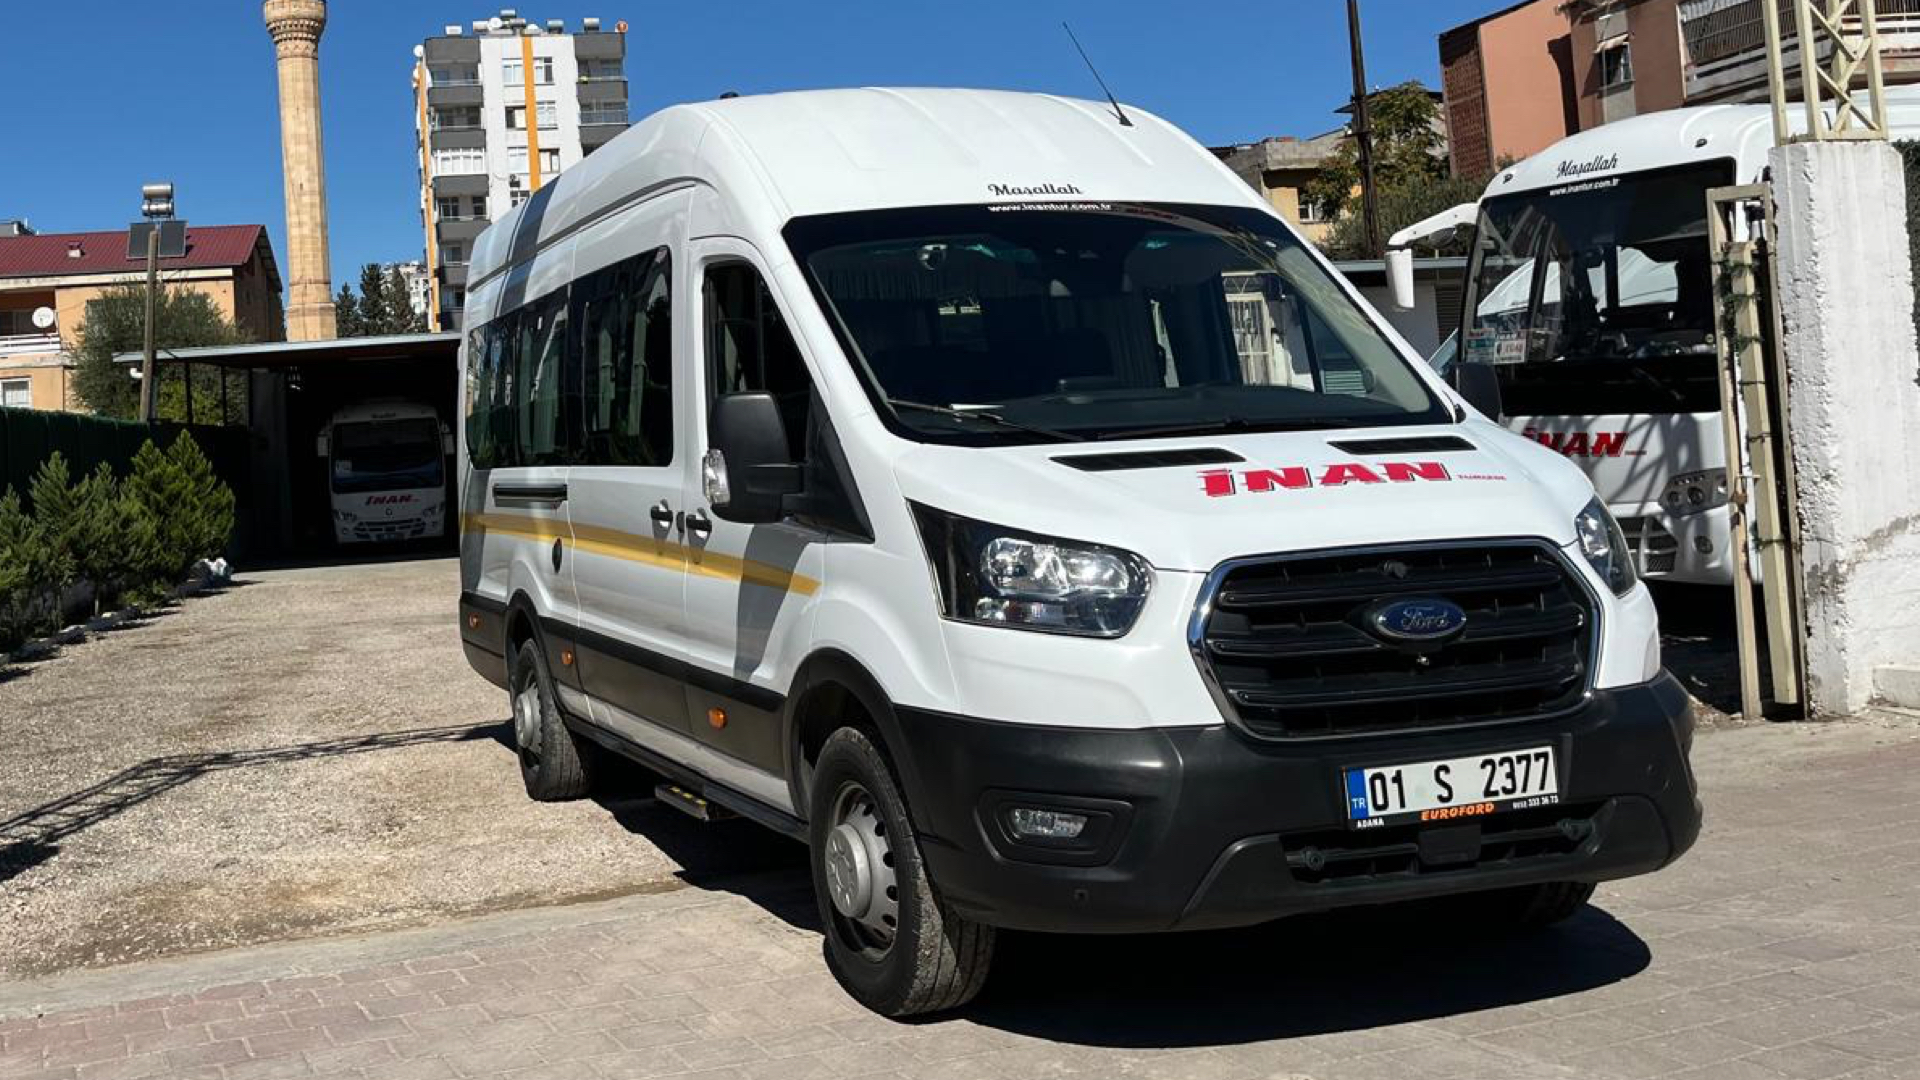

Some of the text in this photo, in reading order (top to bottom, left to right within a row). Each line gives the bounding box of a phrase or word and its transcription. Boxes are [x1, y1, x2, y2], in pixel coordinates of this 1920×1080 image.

[1401, 606, 1449, 630] Ford
[1368, 751, 1549, 812] 01 S 2377
[1351, 797, 1366, 809] TR
[1420, 802, 1495, 821] EUROFORD
[1356, 818, 1385, 829] ADANA
